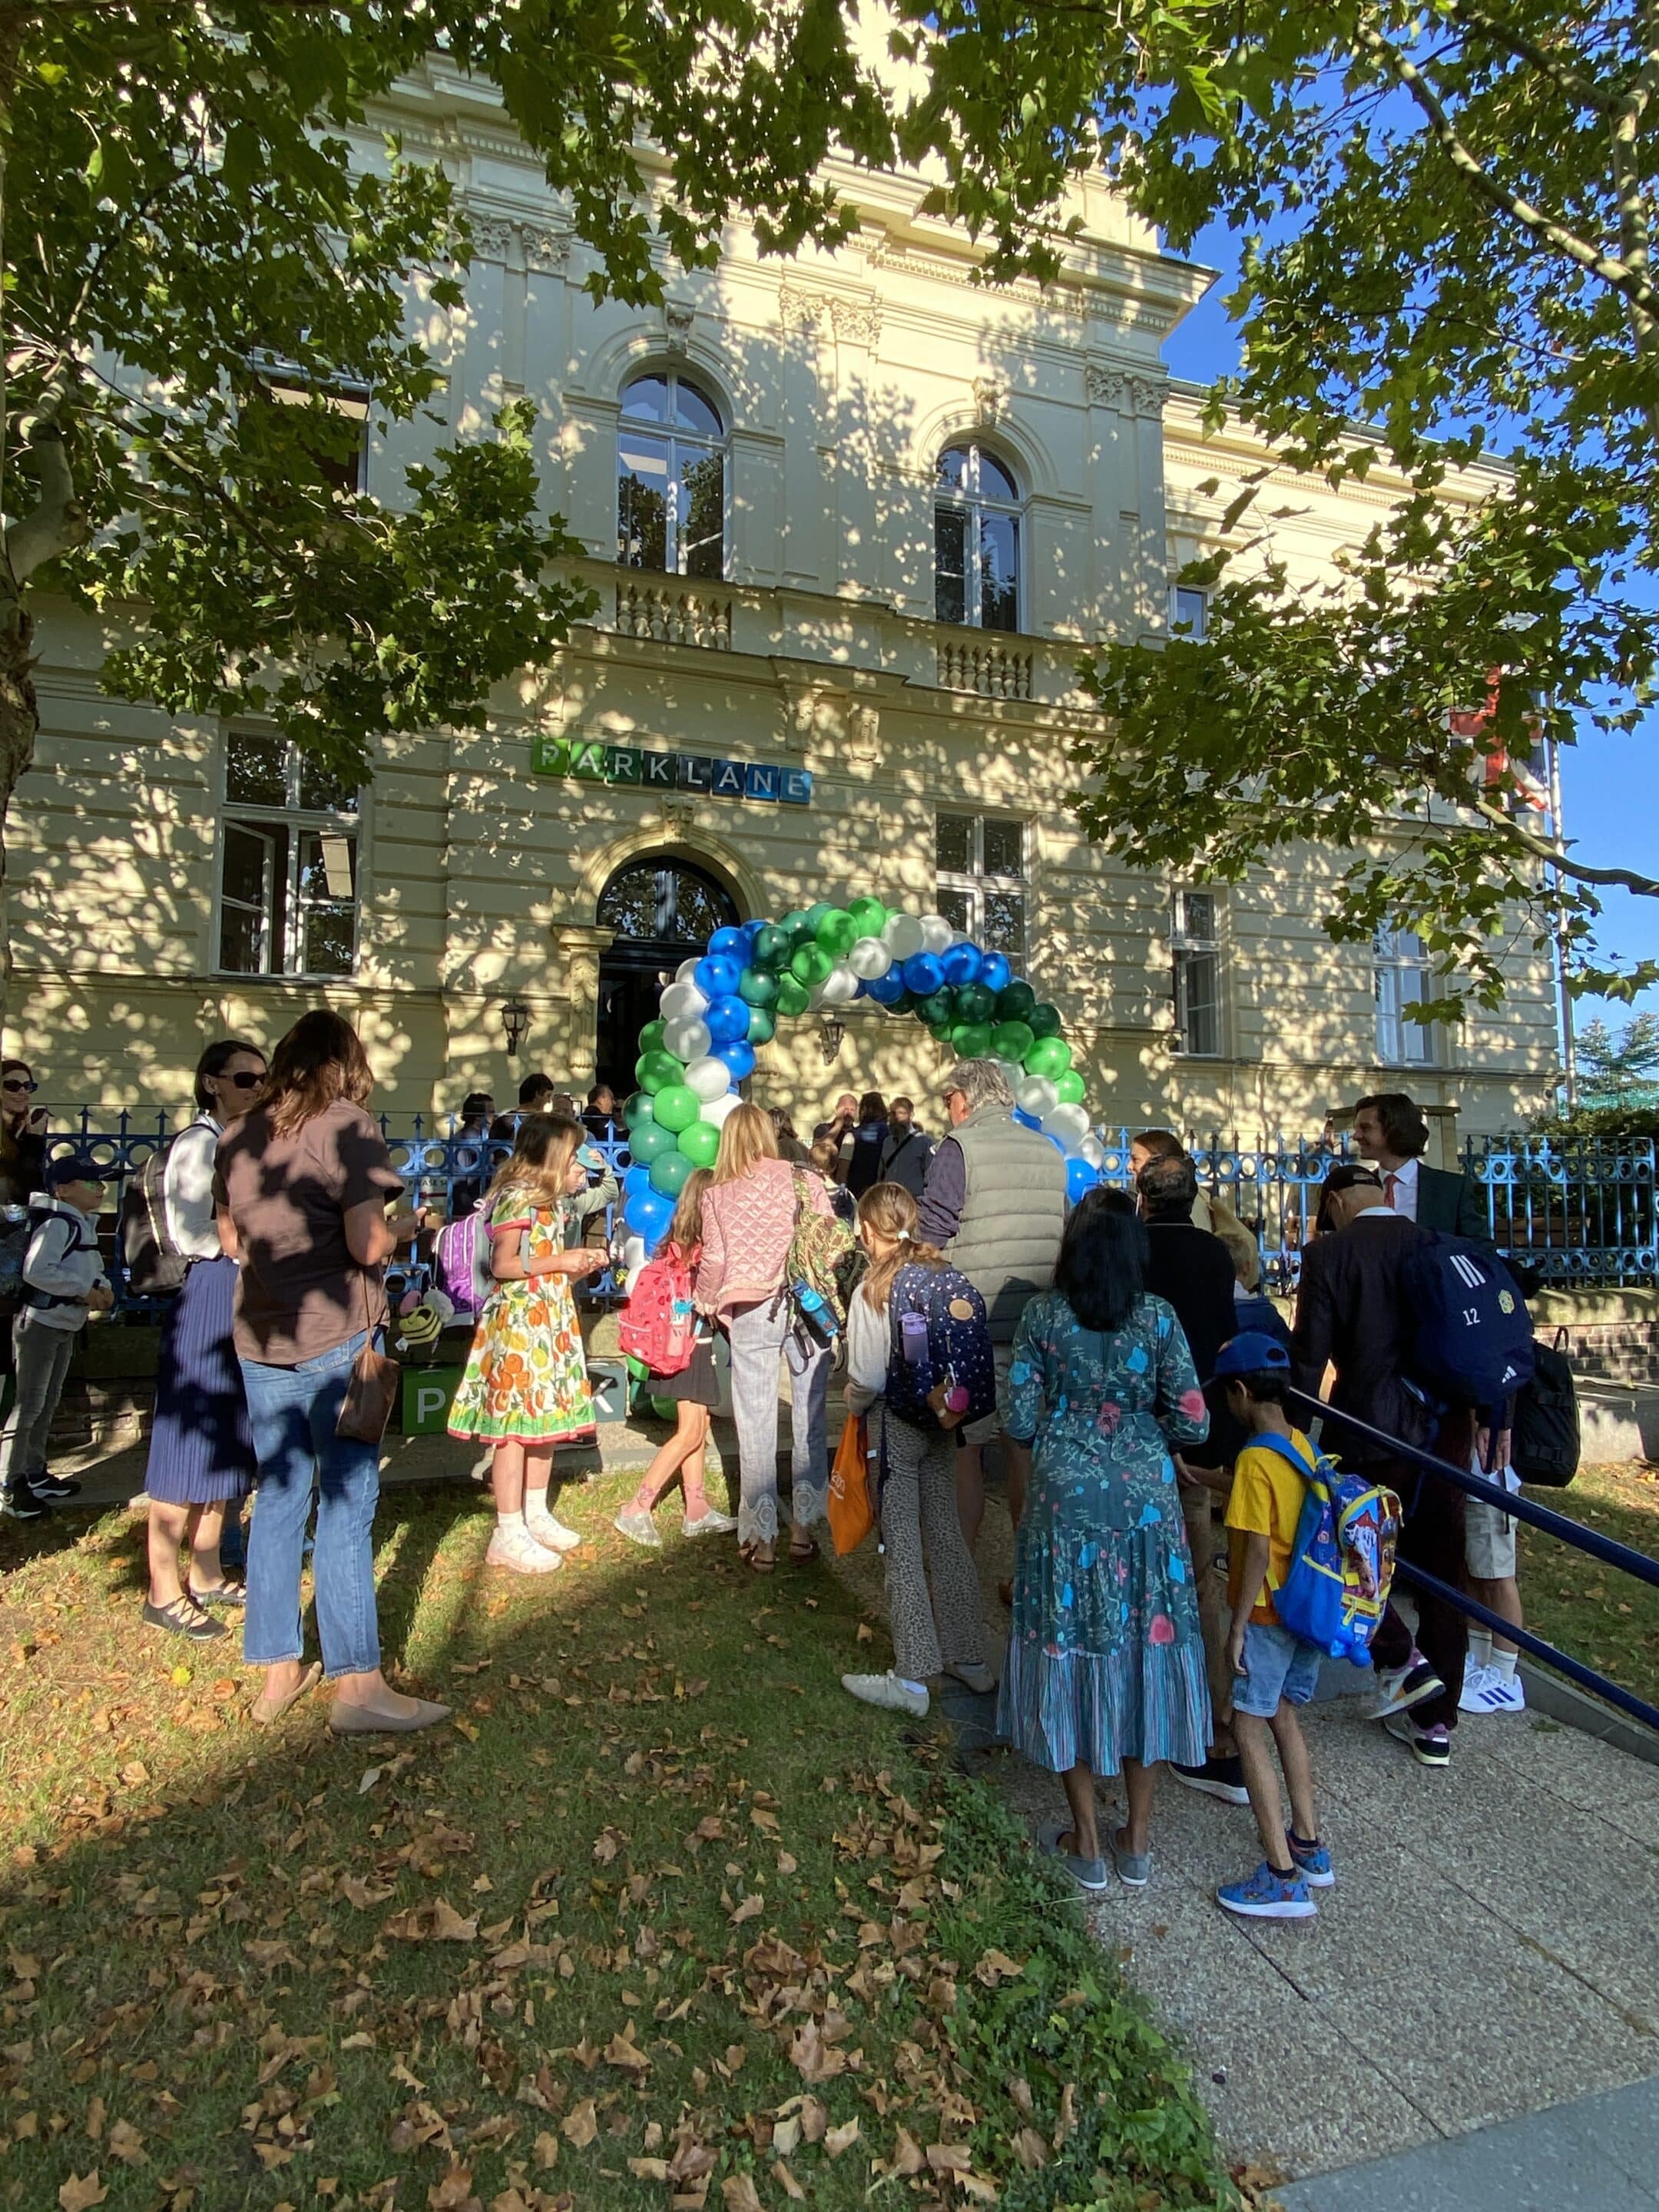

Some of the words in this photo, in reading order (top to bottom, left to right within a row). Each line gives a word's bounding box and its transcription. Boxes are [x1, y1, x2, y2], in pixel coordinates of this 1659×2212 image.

[541, 743, 804, 797] PARKLANE
[1462, 1307, 1481, 1326] 12
[417, 1387, 446, 1423] P
